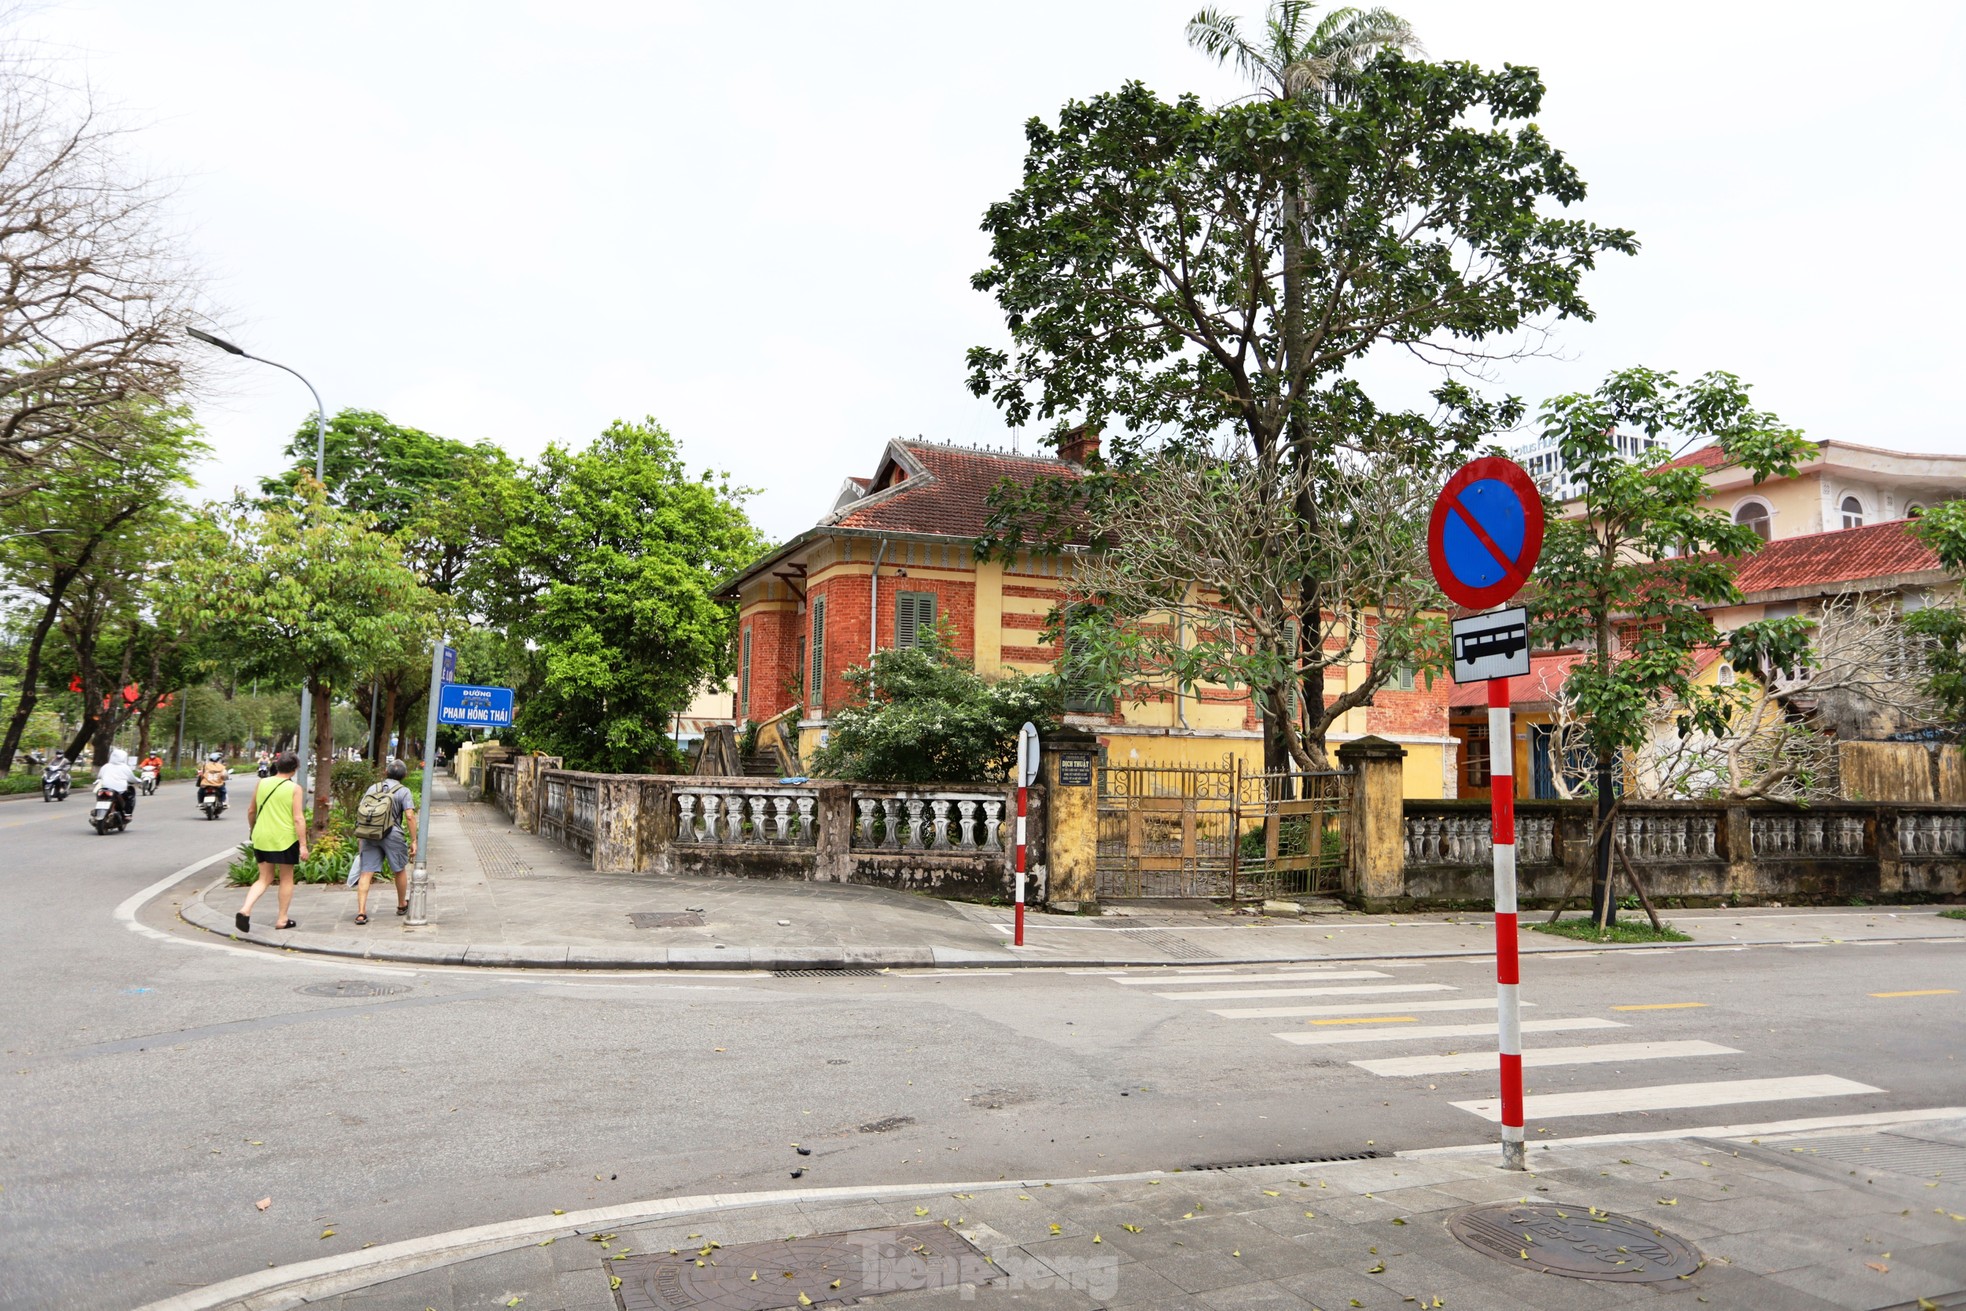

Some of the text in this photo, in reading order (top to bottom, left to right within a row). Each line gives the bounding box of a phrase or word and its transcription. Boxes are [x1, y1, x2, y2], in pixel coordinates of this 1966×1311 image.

[463, 689, 492, 697] ĐƯỜNG
[443, 704, 508, 722] PHẠM HỒNG THÁI
